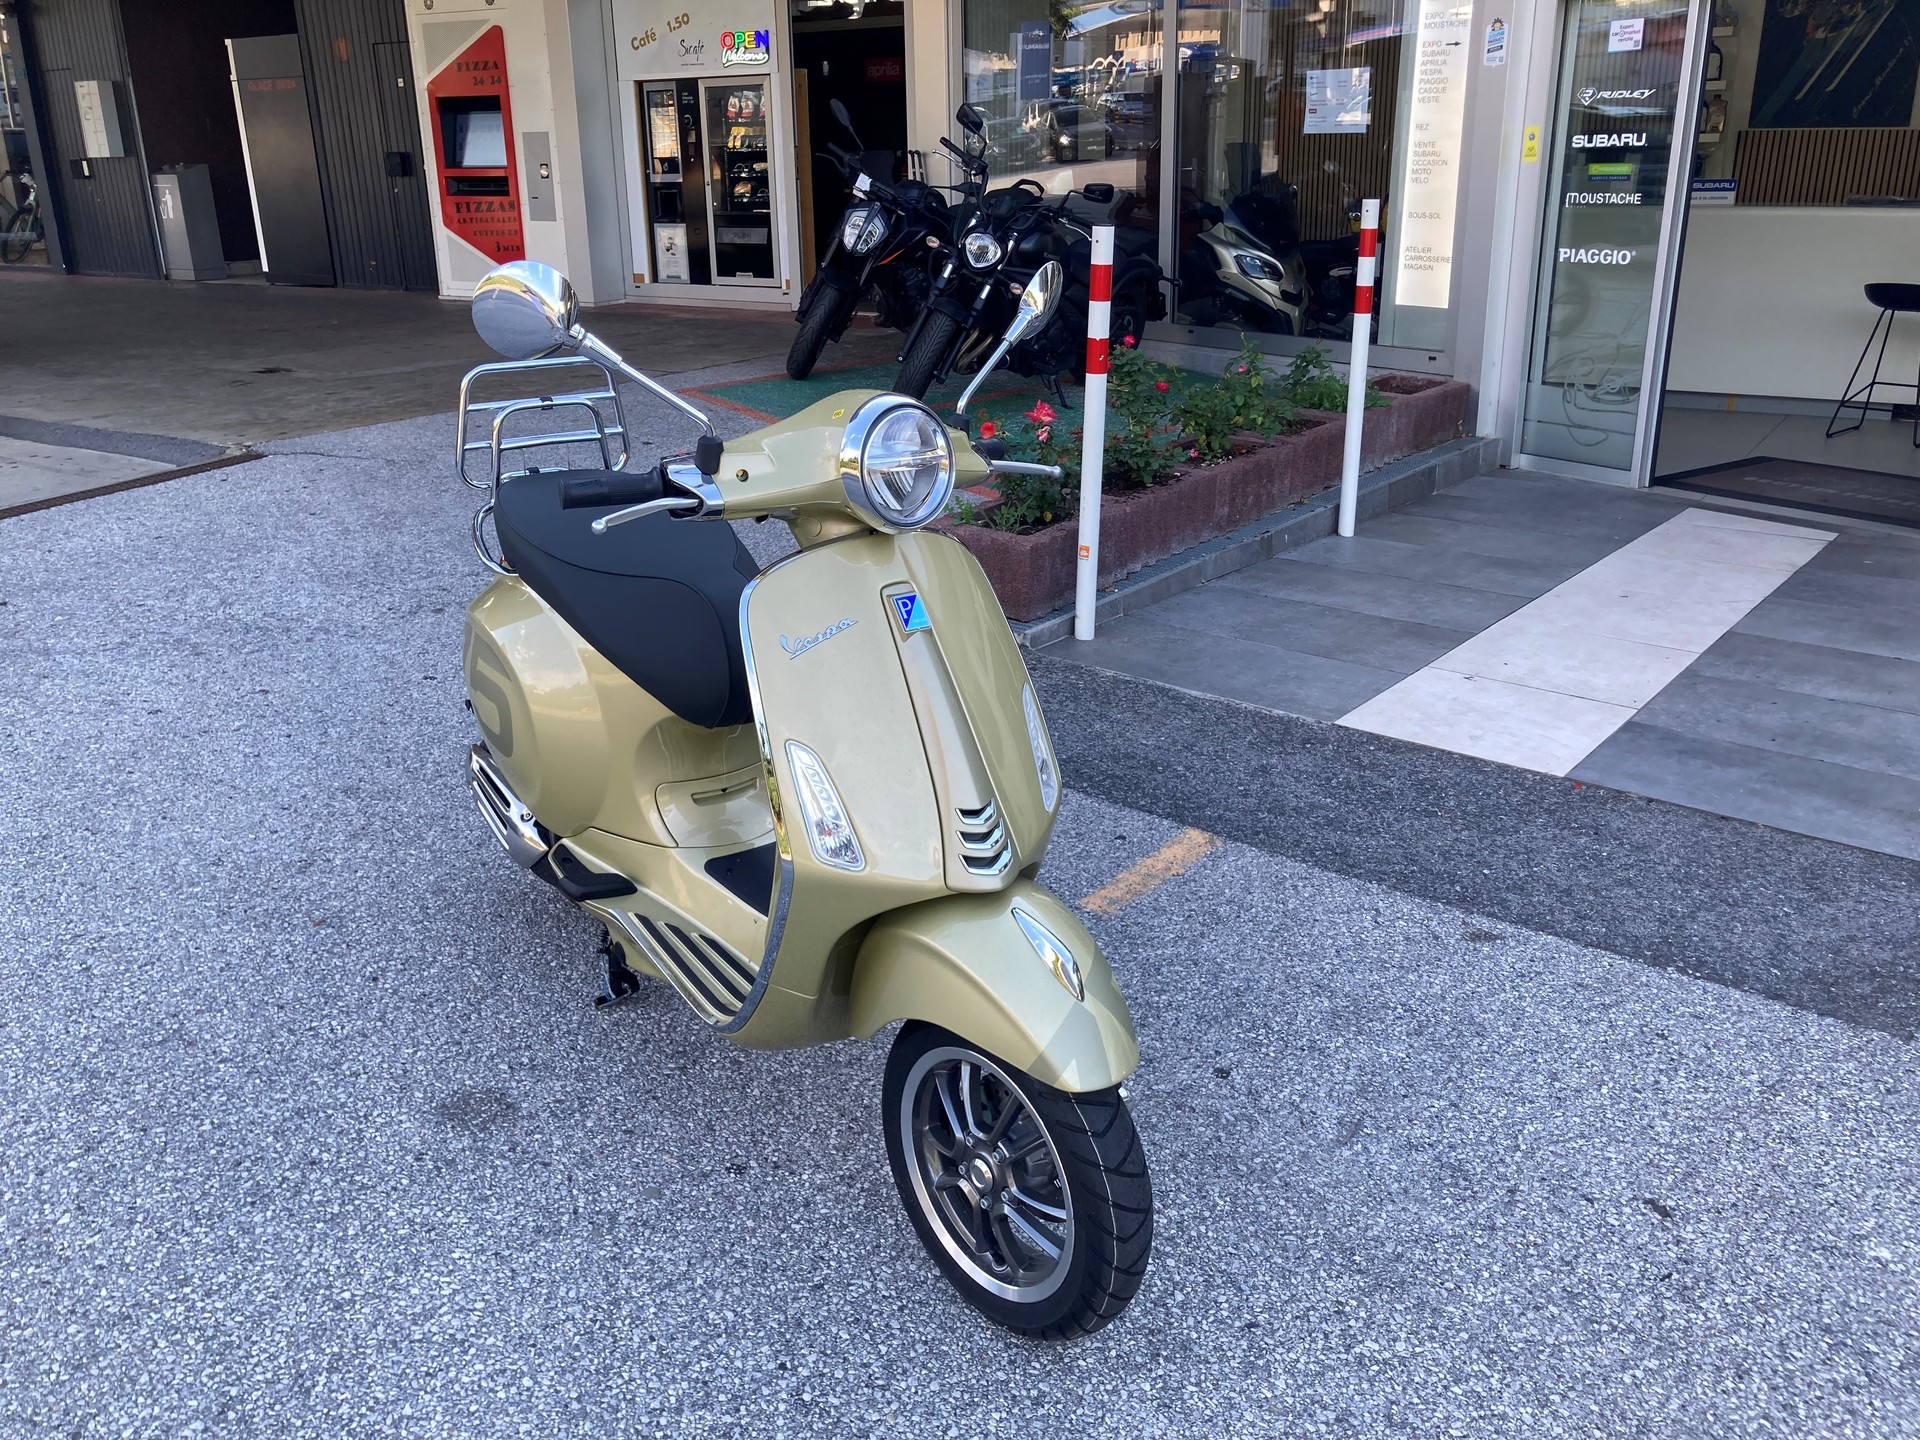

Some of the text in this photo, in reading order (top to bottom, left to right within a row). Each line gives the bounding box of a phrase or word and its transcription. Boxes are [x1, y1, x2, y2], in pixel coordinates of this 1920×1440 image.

[1425, 11, 1445, 20] EXPO
[1424, 20, 1469, 30] MOUSTACHE
[630, 12, 690, 51] Café 1.50
[720, 29, 769, 50] OPEN
[1422, 40, 1442, 48] EXPO
[722, 47, 770, 68] Welcome
[1421, 49, 1451, 58] SUBARU
[455, 60, 500, 73] PIZZA
[1420, 59, 1447, 67] APRILIA
[867, 61, 900, 79] aprilia
[1419, 68, 1443, 76] VESPA
[1418, 77, 1449, 86] PIAGGIO
[1418, 86, 1447, 95] CASQUE
[1597, 88, 1657, 100] RIDLEY
[1417, 96, 1440, 104] VESTE
[1415, 123, 1430, 131] REZ
[1413, 141, 1437, 149] VENTE
[1413, 150, 1442, 158] SUBARU
[1412, 159, 1449, 167] OCCASION
[1411, 168, 1432, 176] MOTO
[1565, 192, 1642, 208] MOUSTACHE
[454, 200, 517, 214] PIZZAS
[1408, 211, 1443, 220] SOUS-SOL
[1404, 246, 1432, 254] ATELIER
[1404, 254, 1452, 264] CARROSSERIE
[1403, 263, 1434, 272] MAGASIN
[779, 617, 859, 661] Vespa
